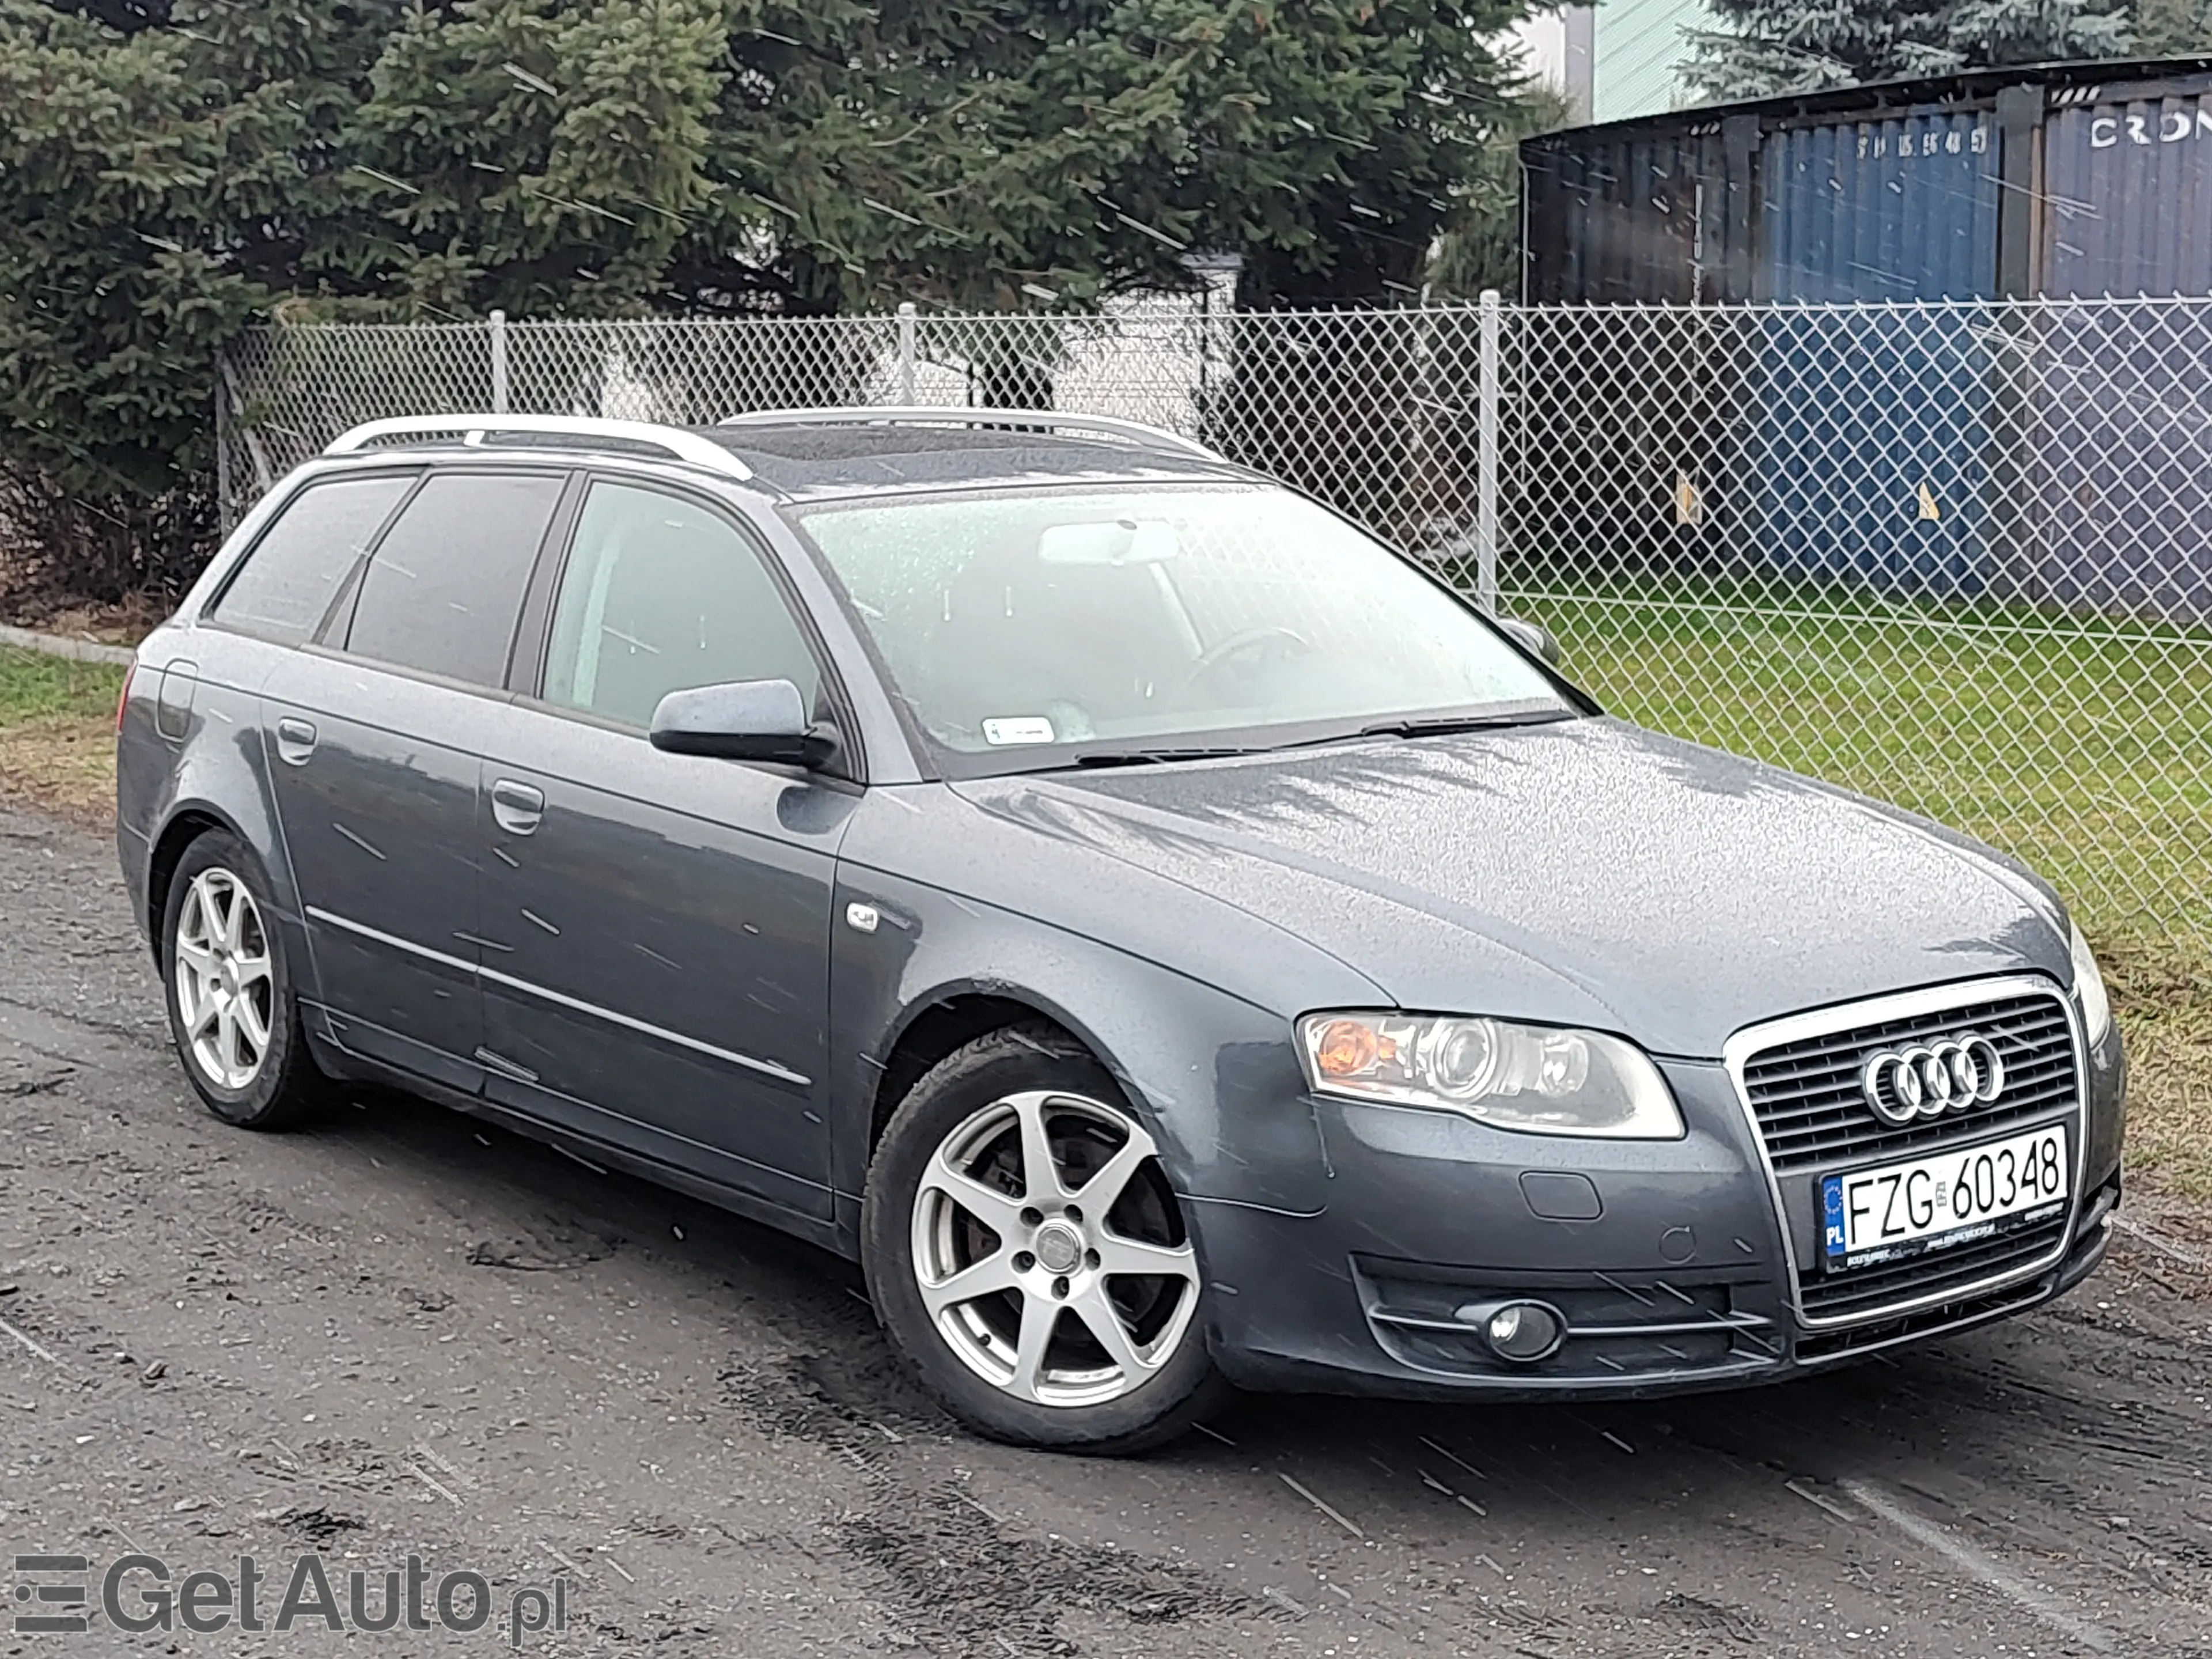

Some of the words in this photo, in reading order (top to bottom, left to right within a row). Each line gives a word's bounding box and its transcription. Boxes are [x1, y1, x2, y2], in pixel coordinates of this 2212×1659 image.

[1848, 1169, 1934, 1245] FZG
[1952, 1137, 2059, 1219] 60348
[1826, 1225, 1844, 1247] PL
